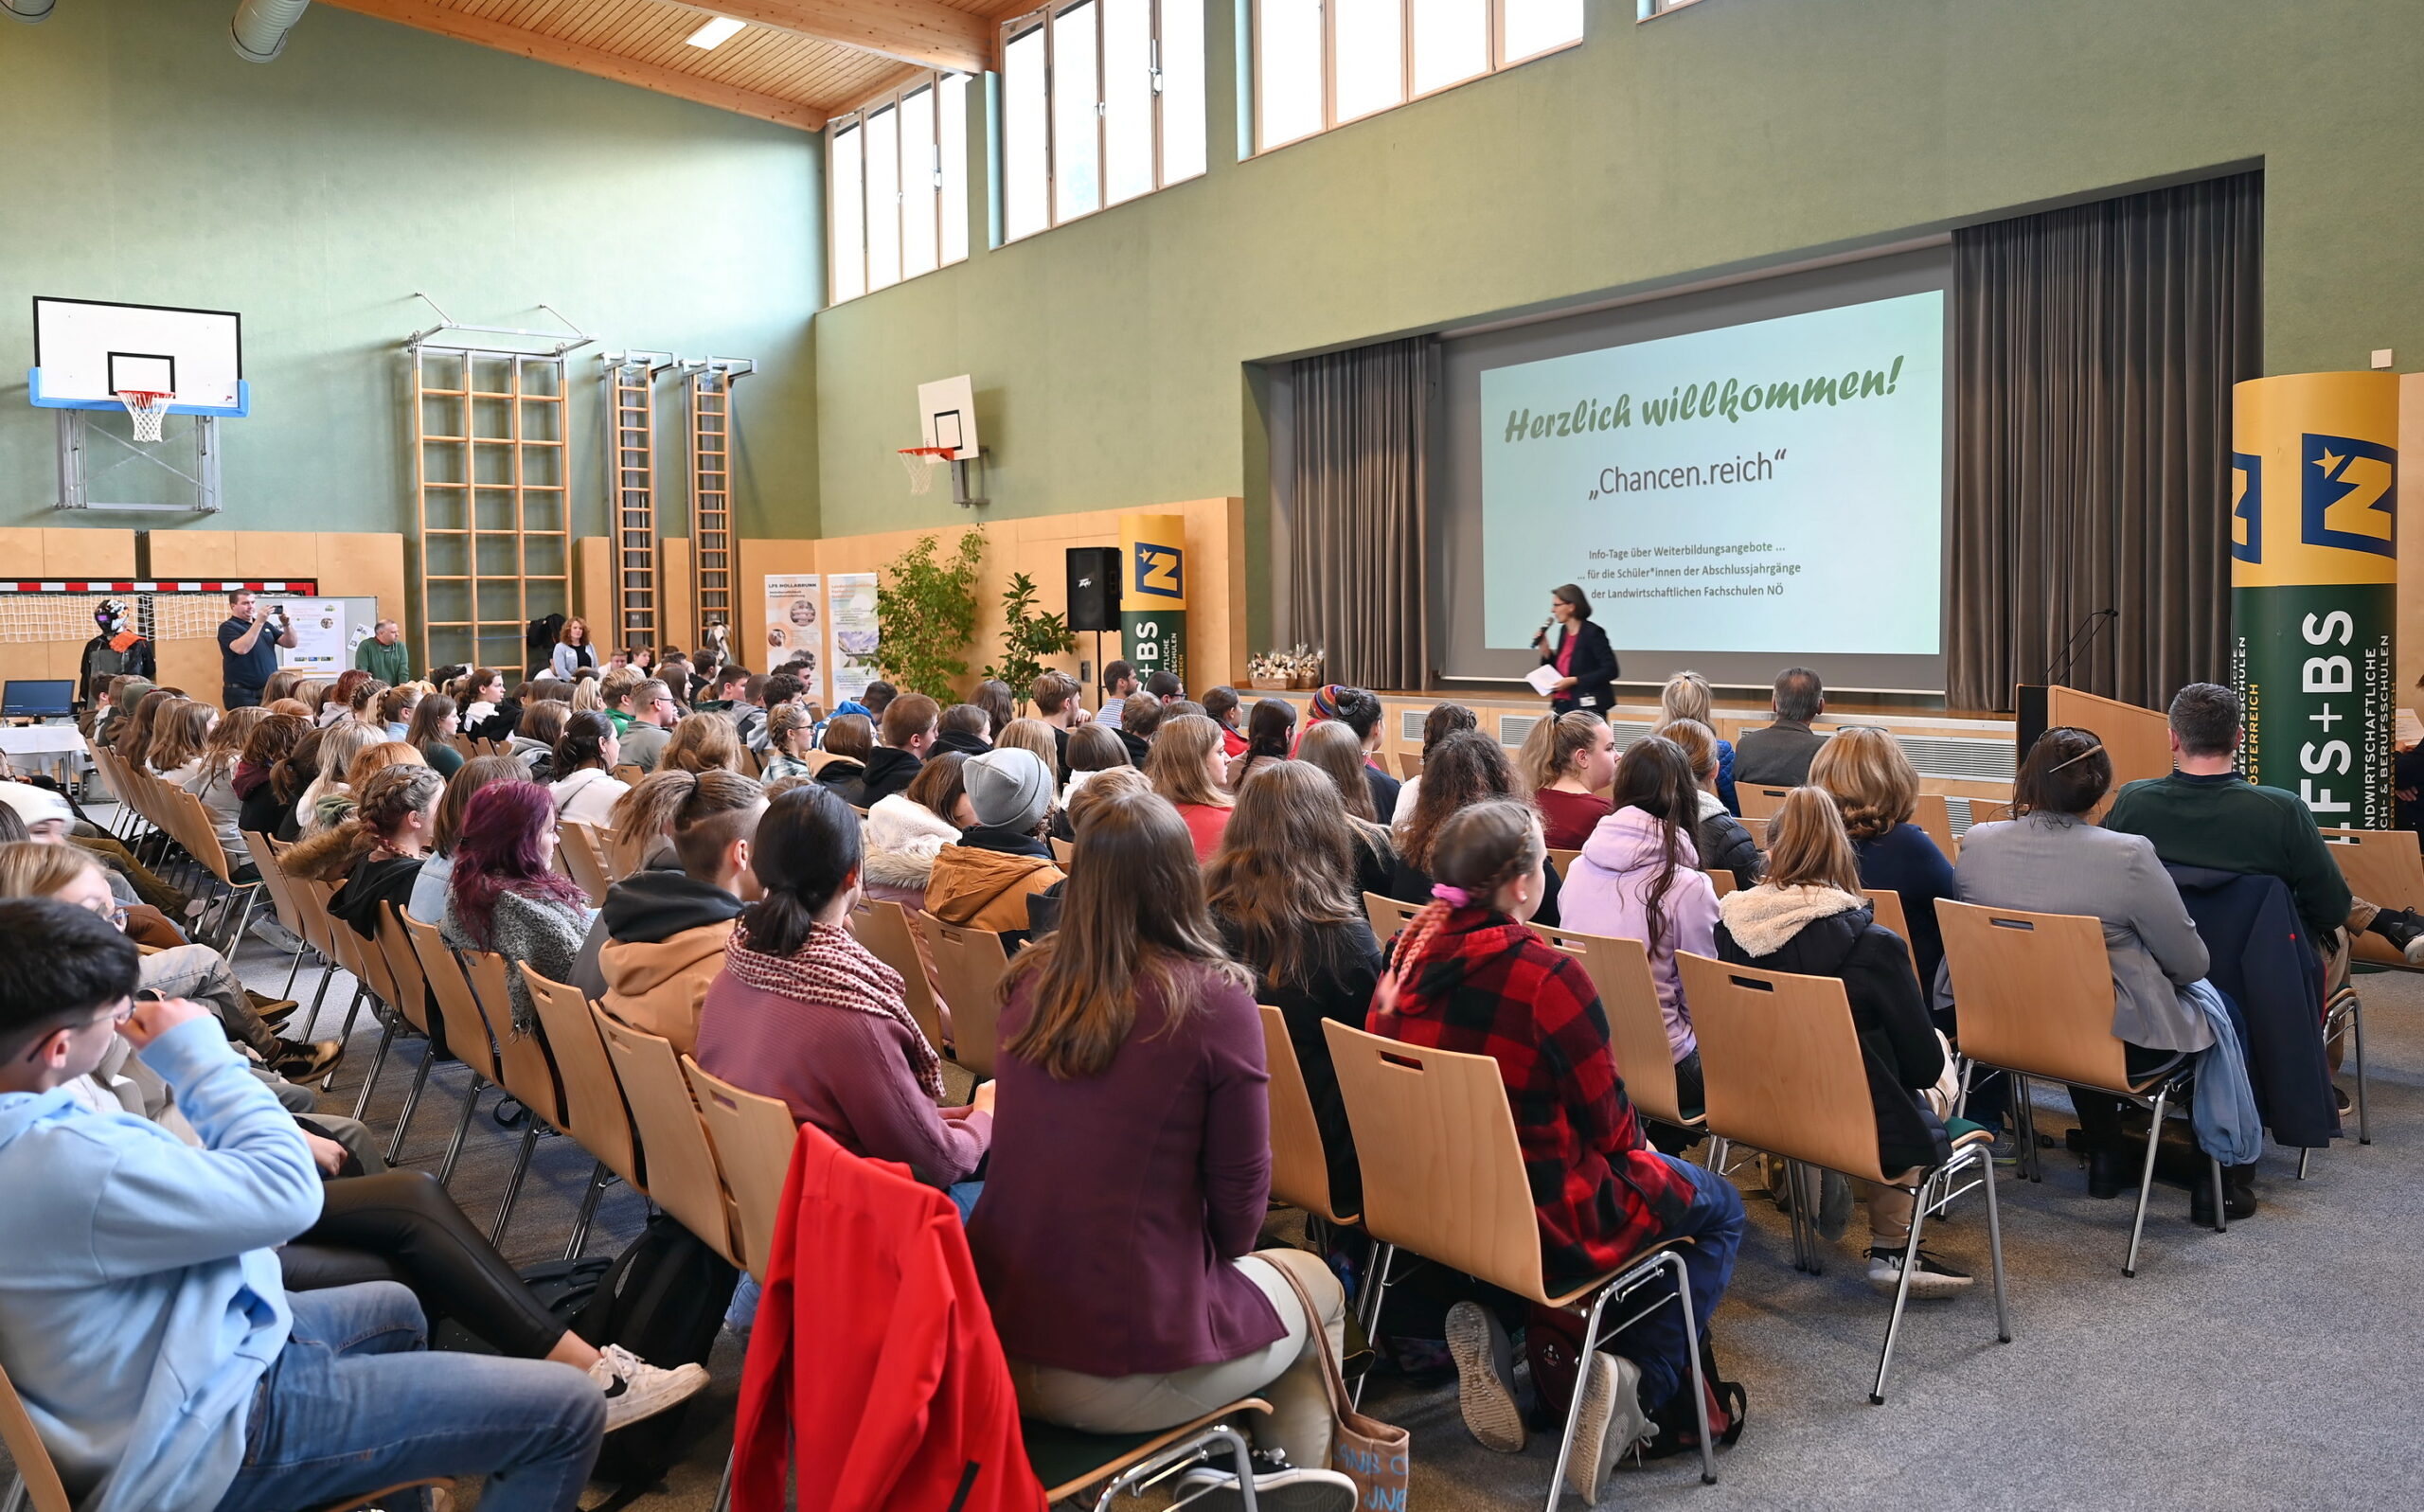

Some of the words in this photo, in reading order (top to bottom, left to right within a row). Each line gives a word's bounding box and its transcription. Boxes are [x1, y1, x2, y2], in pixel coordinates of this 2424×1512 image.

[1505, 393, 1631, 443] Herzlich
[1642, 355, 1904, 426] willkommen!
[1589, 548, 1629, 561] Info-Tage
[1631, 546, 1652, 559] über
[1653, 542, 1773, 559] Weiterbildungsangebote
[1587, 568, 1600, 580] für
[1601, 568, 1615, 579] die
[1683, 565, 1701, 577] der
[1702, 562, 1802, 577] Abschlussjahrgänge
[1591, 589, 1606, 599] der
[1607, 587, 1702, 599] Landwirtschaftlichen
[1703, 584, 1765, 597] Fachschulen
[1767, 581, 1784, 596] NÖ
[2380, 635, 2389, 778] BERUFSSCHULEN
[2364, 648, 2377, 830] NDWIRTSCHAFTLICHE
[2380, 783, 2389, 794] &
[2380, 798, 2389, 830] CH-
